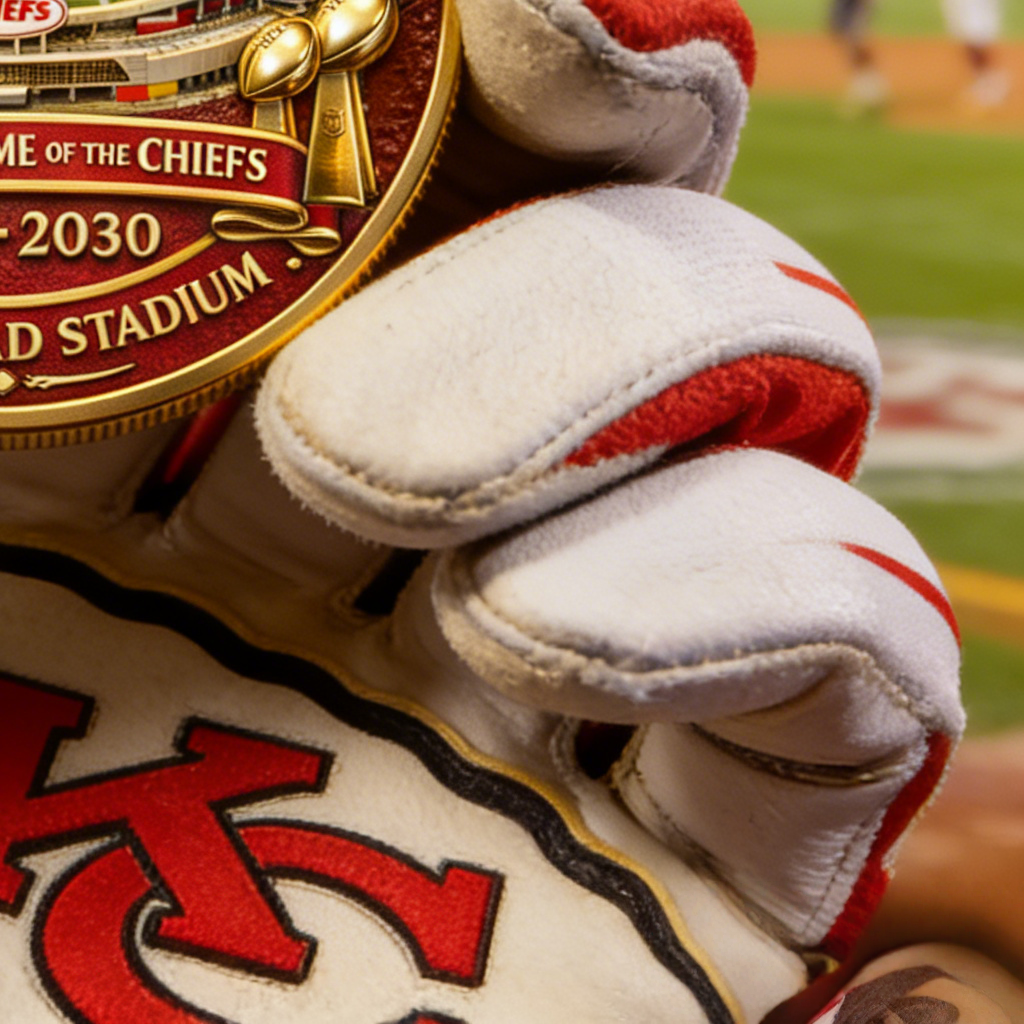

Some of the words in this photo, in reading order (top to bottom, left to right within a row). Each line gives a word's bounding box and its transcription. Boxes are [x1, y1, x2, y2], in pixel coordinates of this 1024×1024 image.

[45, 140, 77, 164] OF
[81, 142, 130, 167] THE
[137, 137, 268, 182] CHIEFS
[57, 250, 273, 358] STADIUM
